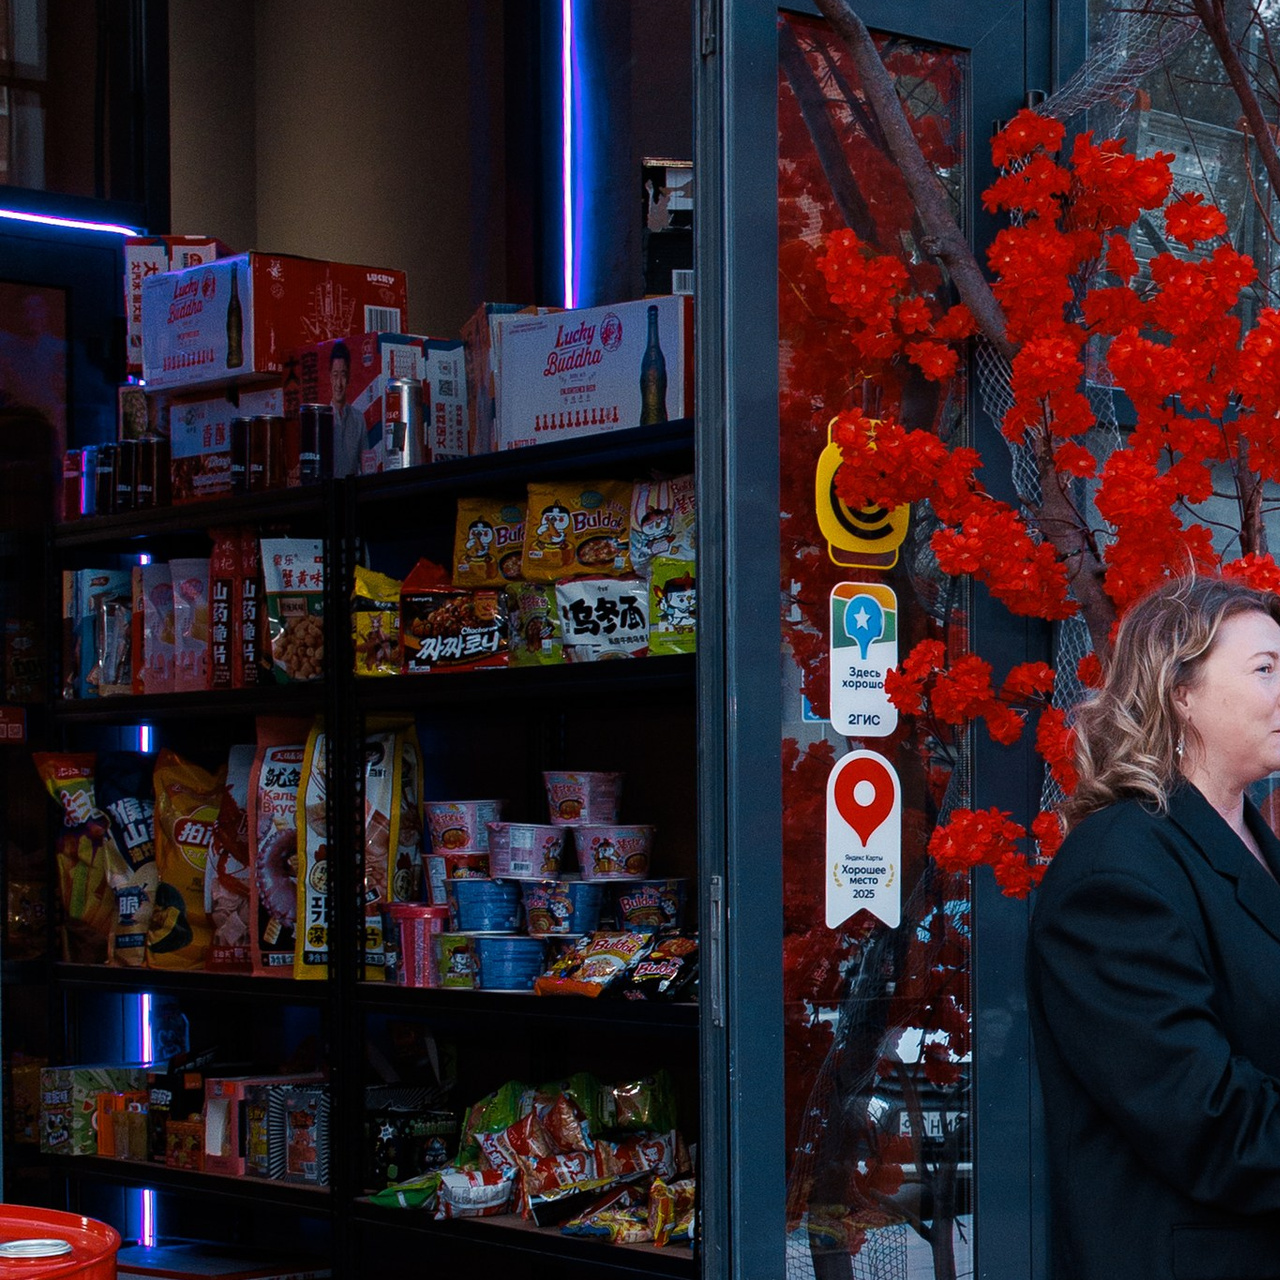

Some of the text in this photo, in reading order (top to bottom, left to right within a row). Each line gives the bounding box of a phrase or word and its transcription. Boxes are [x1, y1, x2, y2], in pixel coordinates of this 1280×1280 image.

[173, 277, 200, 301] Lucky
[166, 299, 204, 325] Buddha
[555, 321, 596, 348] Lucky
[543, 347, 603, 377] Buddha
[571, 510, 623, 533] Buldak
[415, 631, 500, 661] 짜짜로니
[849, 666, 881, 678] Здесь
[842, 680, 884, 690] хорошо
[848, 713, 881, 725] 2ГИС
[263, 790, 297, 801] Каль
[845, 854, 883, 862] Яндекс Карты
[842, 864, 887, 876] Хорошее
[849, 877, 879, 885] место
[853, 889, 875, 899] 2025
[590, 938, 637, 955] Buldak
